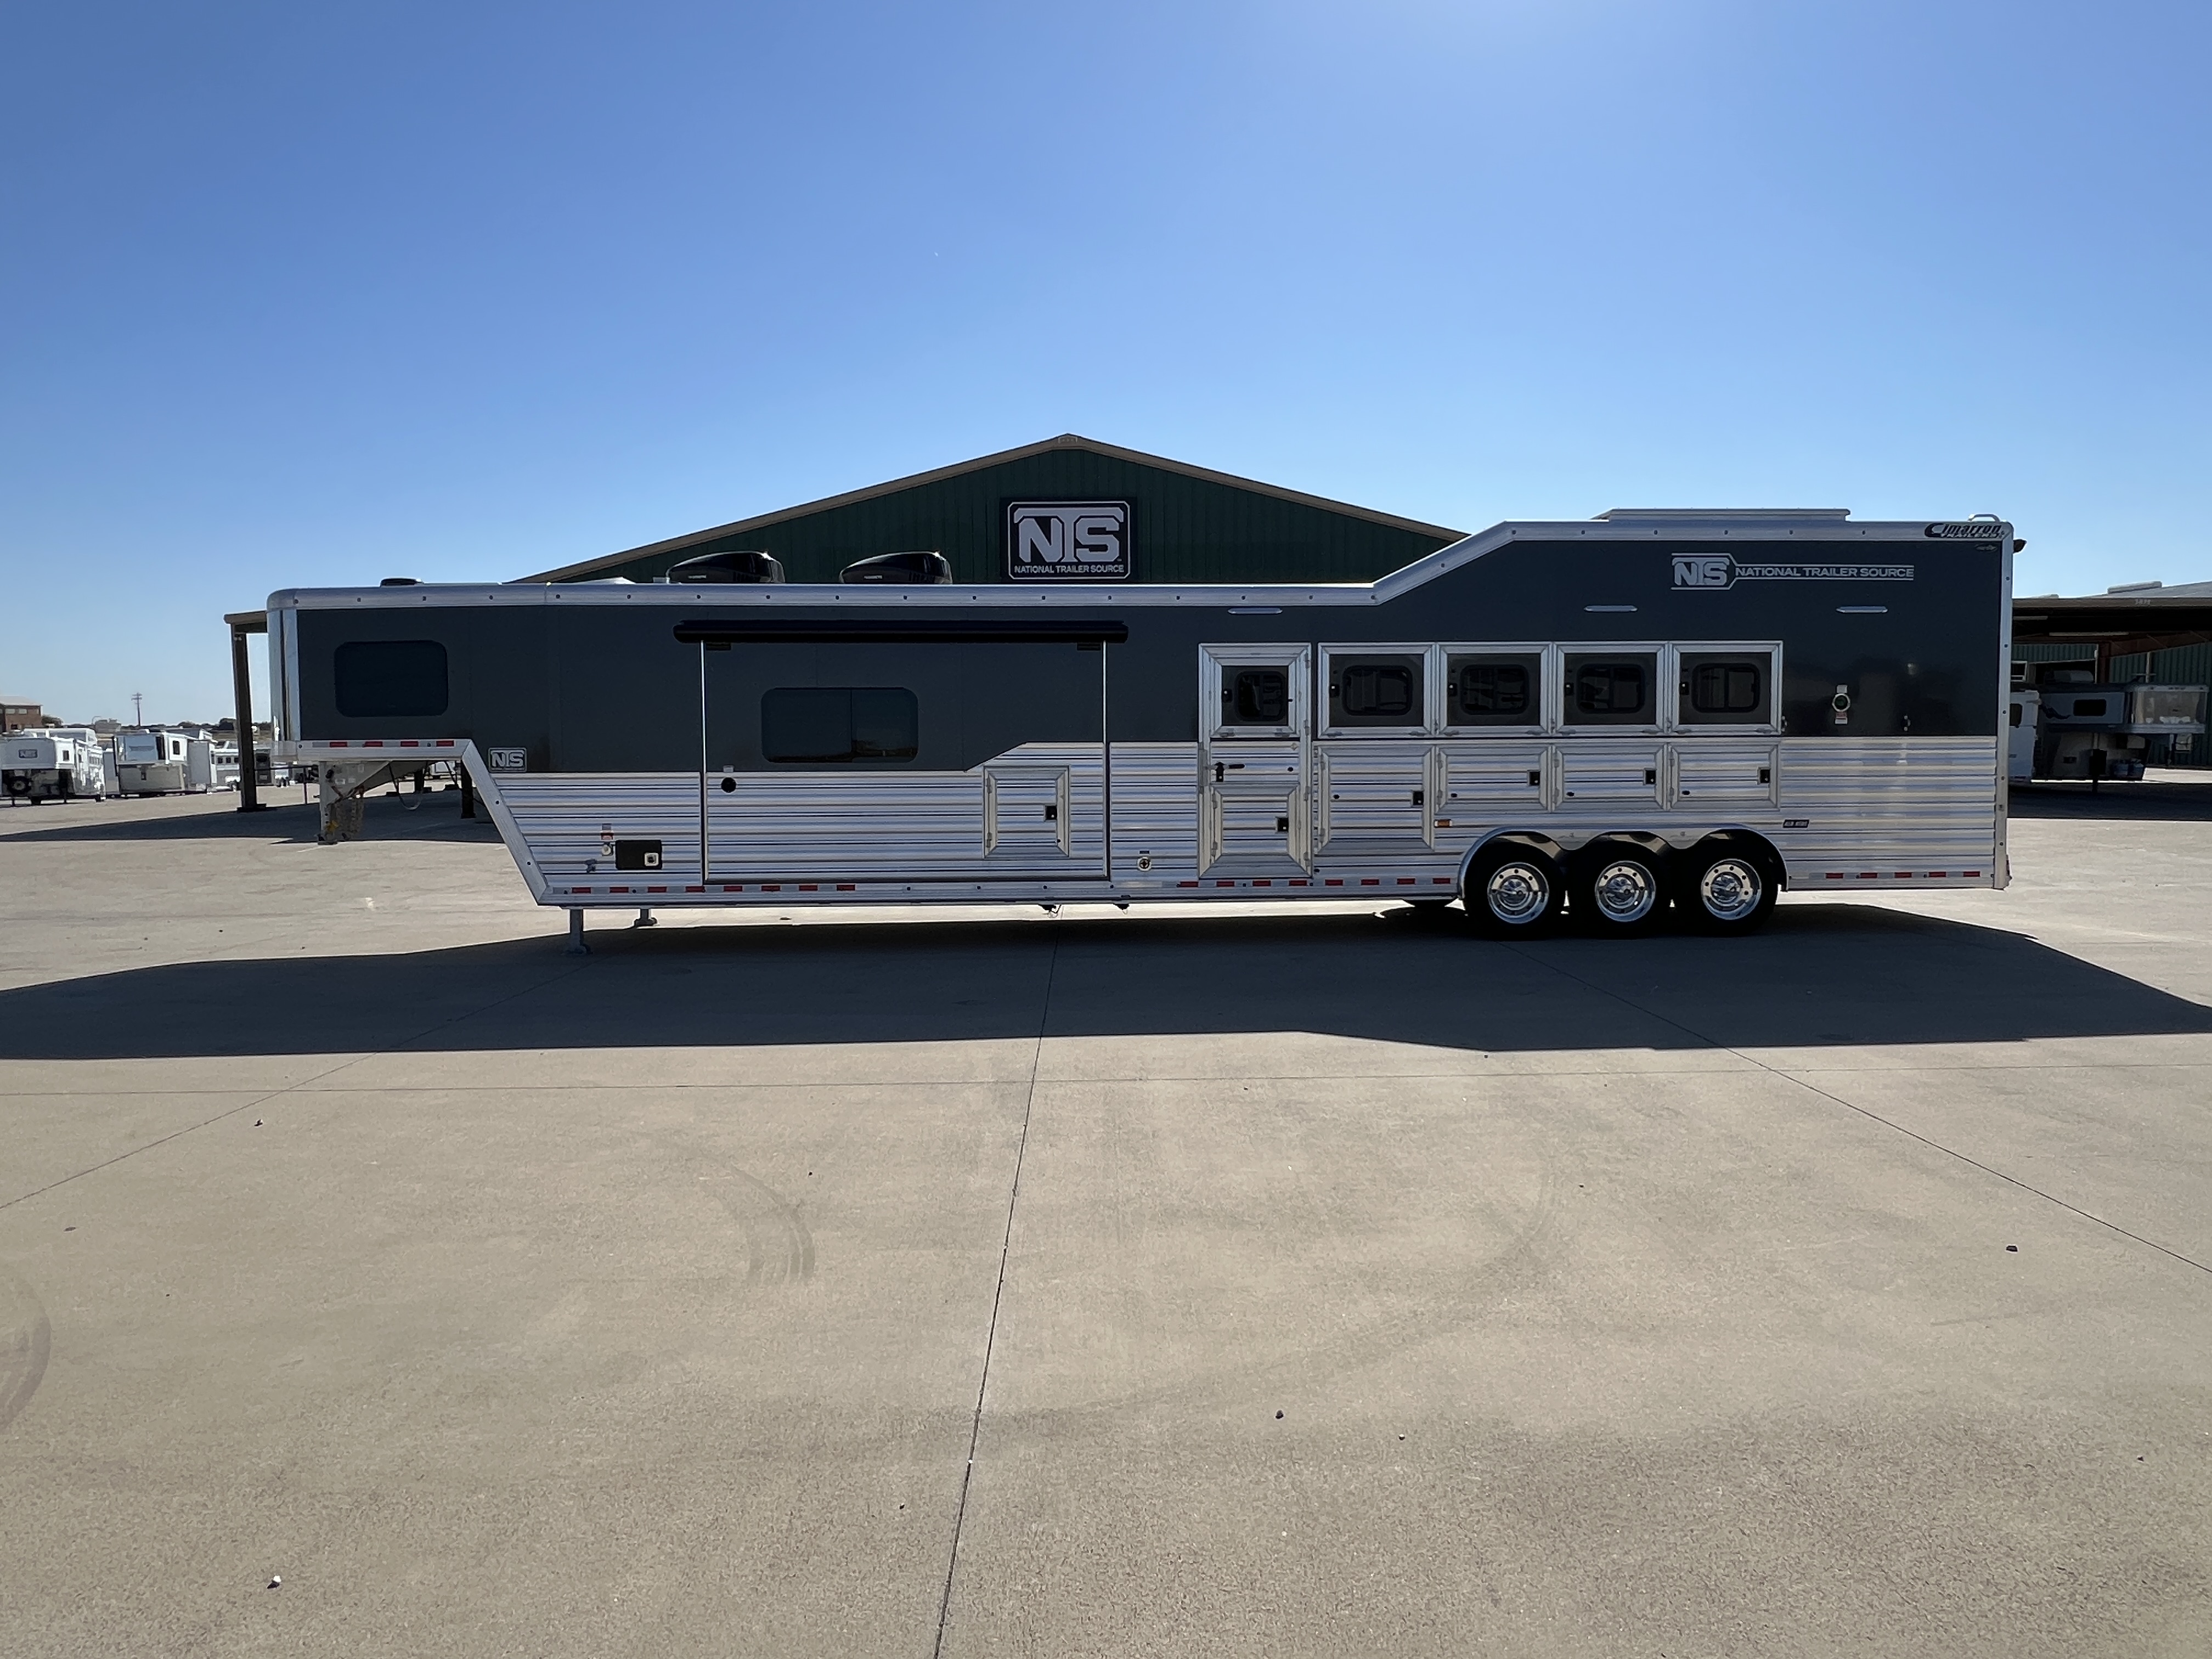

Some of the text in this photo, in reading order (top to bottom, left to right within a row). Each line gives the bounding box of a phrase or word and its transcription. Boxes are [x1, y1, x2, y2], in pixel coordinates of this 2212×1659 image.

[1014, 507, 1124, 562] NTS
[1925, 523, 2001, 538] Cimarron
[1014, 565, 1125, 573] NATIONAL TRAILER SOURCE
[1672, 557, 1730, 585] NTS
[1735, 567, 1914, 577] NATIONAL TRAILER SOURCE
[490, 749, 524, 767] NTS
